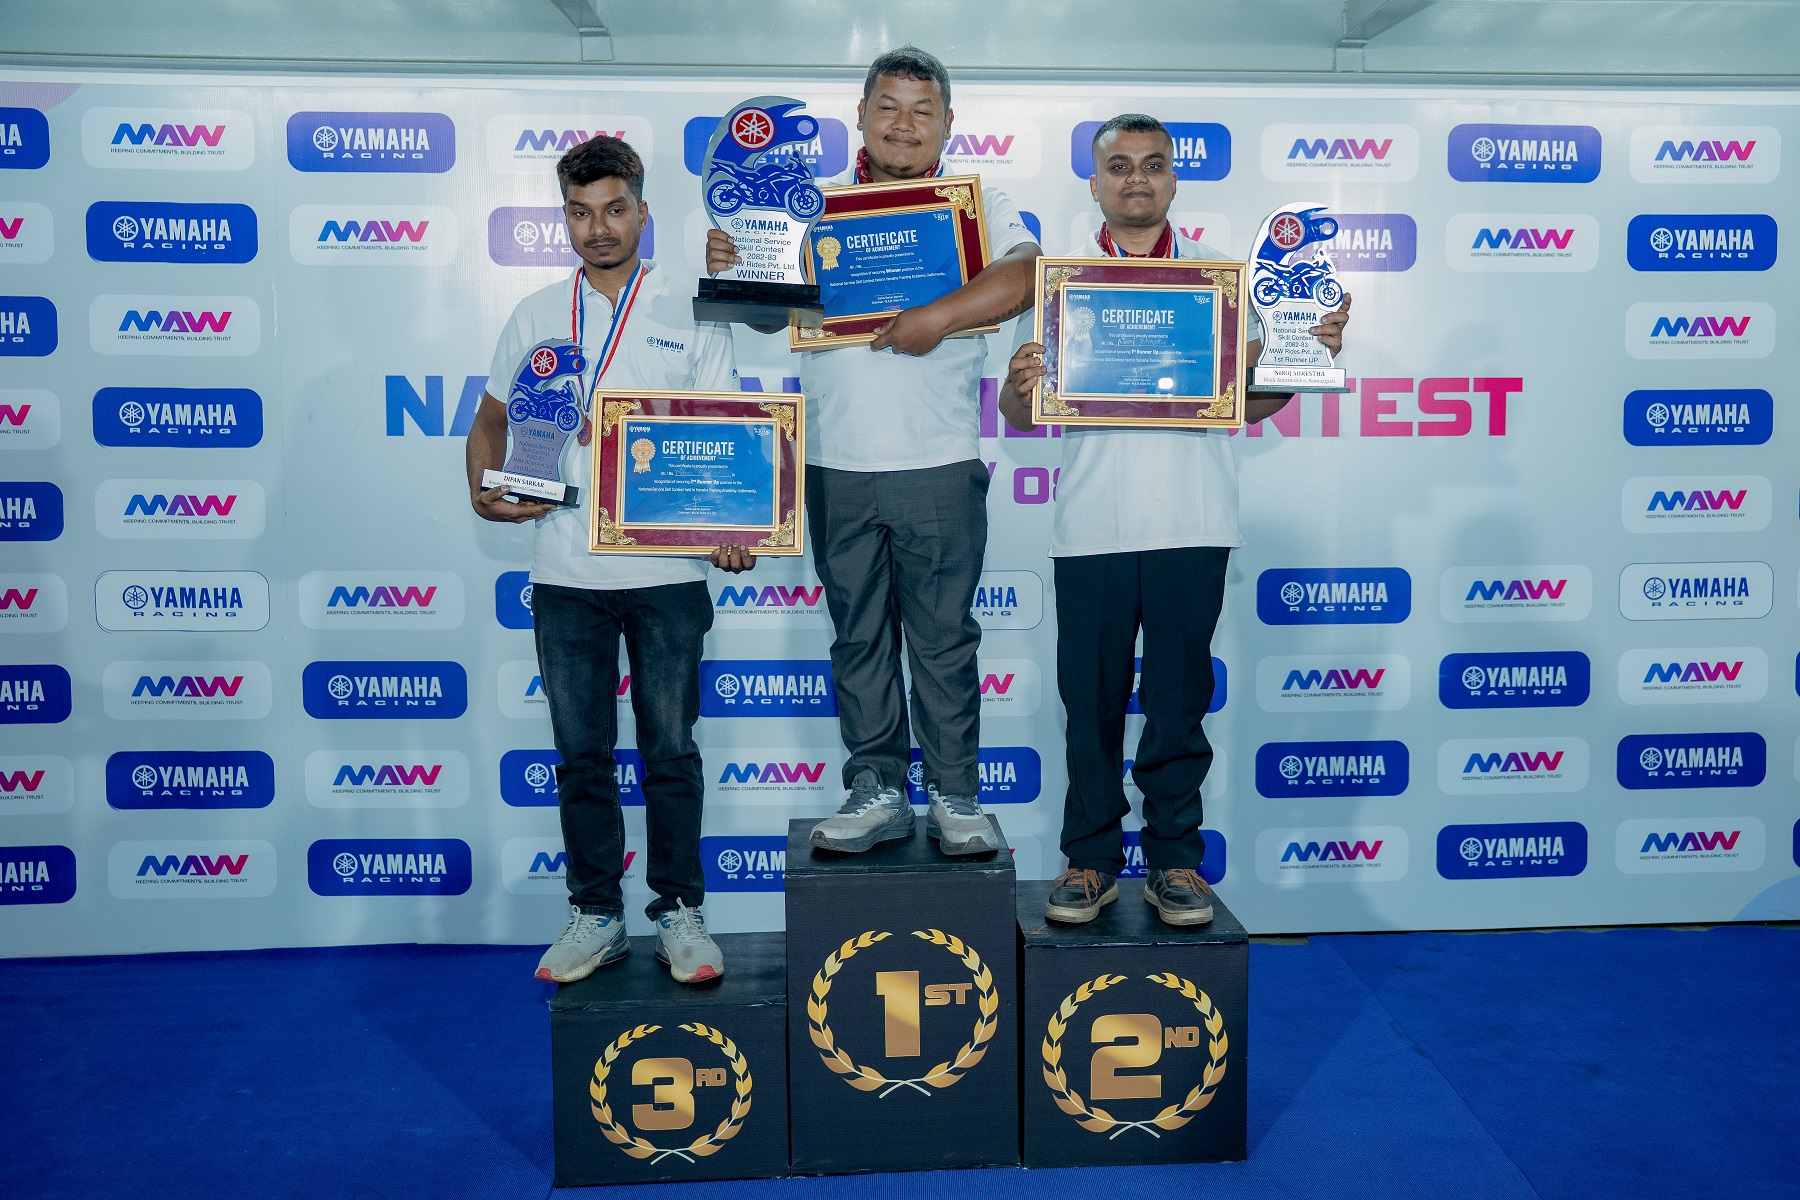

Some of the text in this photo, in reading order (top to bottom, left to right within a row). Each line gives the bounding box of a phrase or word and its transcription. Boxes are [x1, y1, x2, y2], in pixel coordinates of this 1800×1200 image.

[111, 123, 226, 146] MAW
[340, 128, 429, 150] YAMAHA
[943, 134, 1015, 156] AW
[1287, 138, 1393, 159] MAW
[1497, 139, 1578, 161] YAMAHA
[1655, 141, 1756, 161] MAW
[140, 218, 231, 241] YAMAHA
[318, 220, 429, 242] MAW
[745, 219, 788, 232] YAMAHA
[732, 236, 791, 246] National Service
[755, 245, 784, 253] Contest
[846, 229, 918, 249] CERTIFICATE
[1472, 228, 1574, 249] MAW
[1675, 229, 1754, 250] YAMAHA
[736, 269, 785, 280] WINNER
[746, 261, 766, 269] Rides
[118, 310, 232, 333] MAW
[1102, 309, 1175, 324] CERTIFICATE
[1282, 312, 1317, 321] YAMAHA
[1650, 316, 1751, 337] MAW
[655, 338, 684, 351] YAMAHA
[146, 403, 237, 425] YAMAHA
[1671, 404, 1750, 425] YAMAHA
[528, 428, 555, 441] YAMAHA
[662, 441, 735, 456] CERTIFICATE
[504, 475, 545, 488] DIPAN SARKAR
[124, 494, 237, 516] MAW
[1647, 490, 1747, 511] MAW
[150, 587, 243, 608] YAMAHA
[327, 586, 437, 607] MAW
[716, 586, 824, 606] MAW
[1306, 582, 1388, 603] YAMAHA
[1465, 579, 1567, 601] MAW
[1669, 577, 1749, 598] YAMAHA
[1282, 668, 1385, 690] MAW
[1486, 666, 1567, 687] YAMAHA
[1643, 661, 1744, 683] MAW
[131, 676, 244, 697] MAW
[354, 677, 442, 697] YAMAHA
[741, 675, 827, 696] YAMAHA
[1304, 755, 1386, 776] YAMAHA
[1463, 751, 1564, 773] MAW
[1664, 747, 1743, 768] YAMAHA
[159, 766, 249, 787] YAMAHA
[333, 765, 442, 786] MAW
[718, 763, 826, 783] MAW
[1281, 840, 1383, 862] MAW
[1484, 836, 1564, 858] YAMAHA
[1640, 831, 1741, 852] MAW
[136, 854, 249, 876] MAW
[359, 854, 447, 874] YAMAHA
